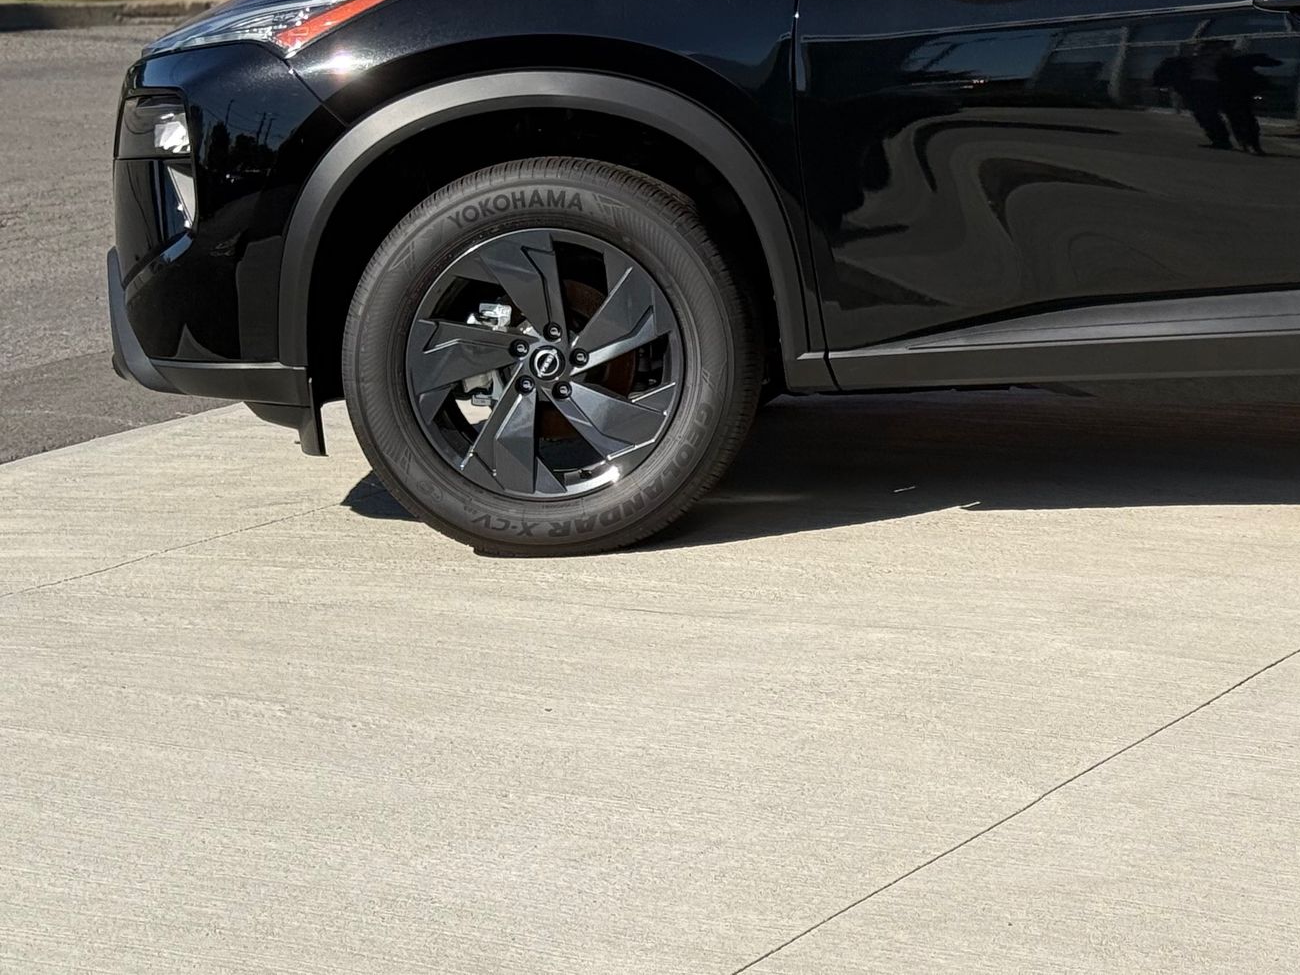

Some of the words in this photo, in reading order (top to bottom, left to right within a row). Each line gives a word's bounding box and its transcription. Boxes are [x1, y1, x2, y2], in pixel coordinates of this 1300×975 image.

[448, 189, 583, 228] YOKOHAMA
[547, 402, 715, 538] GEOLANDAR
[470, 513, 542, 538] X-CV
